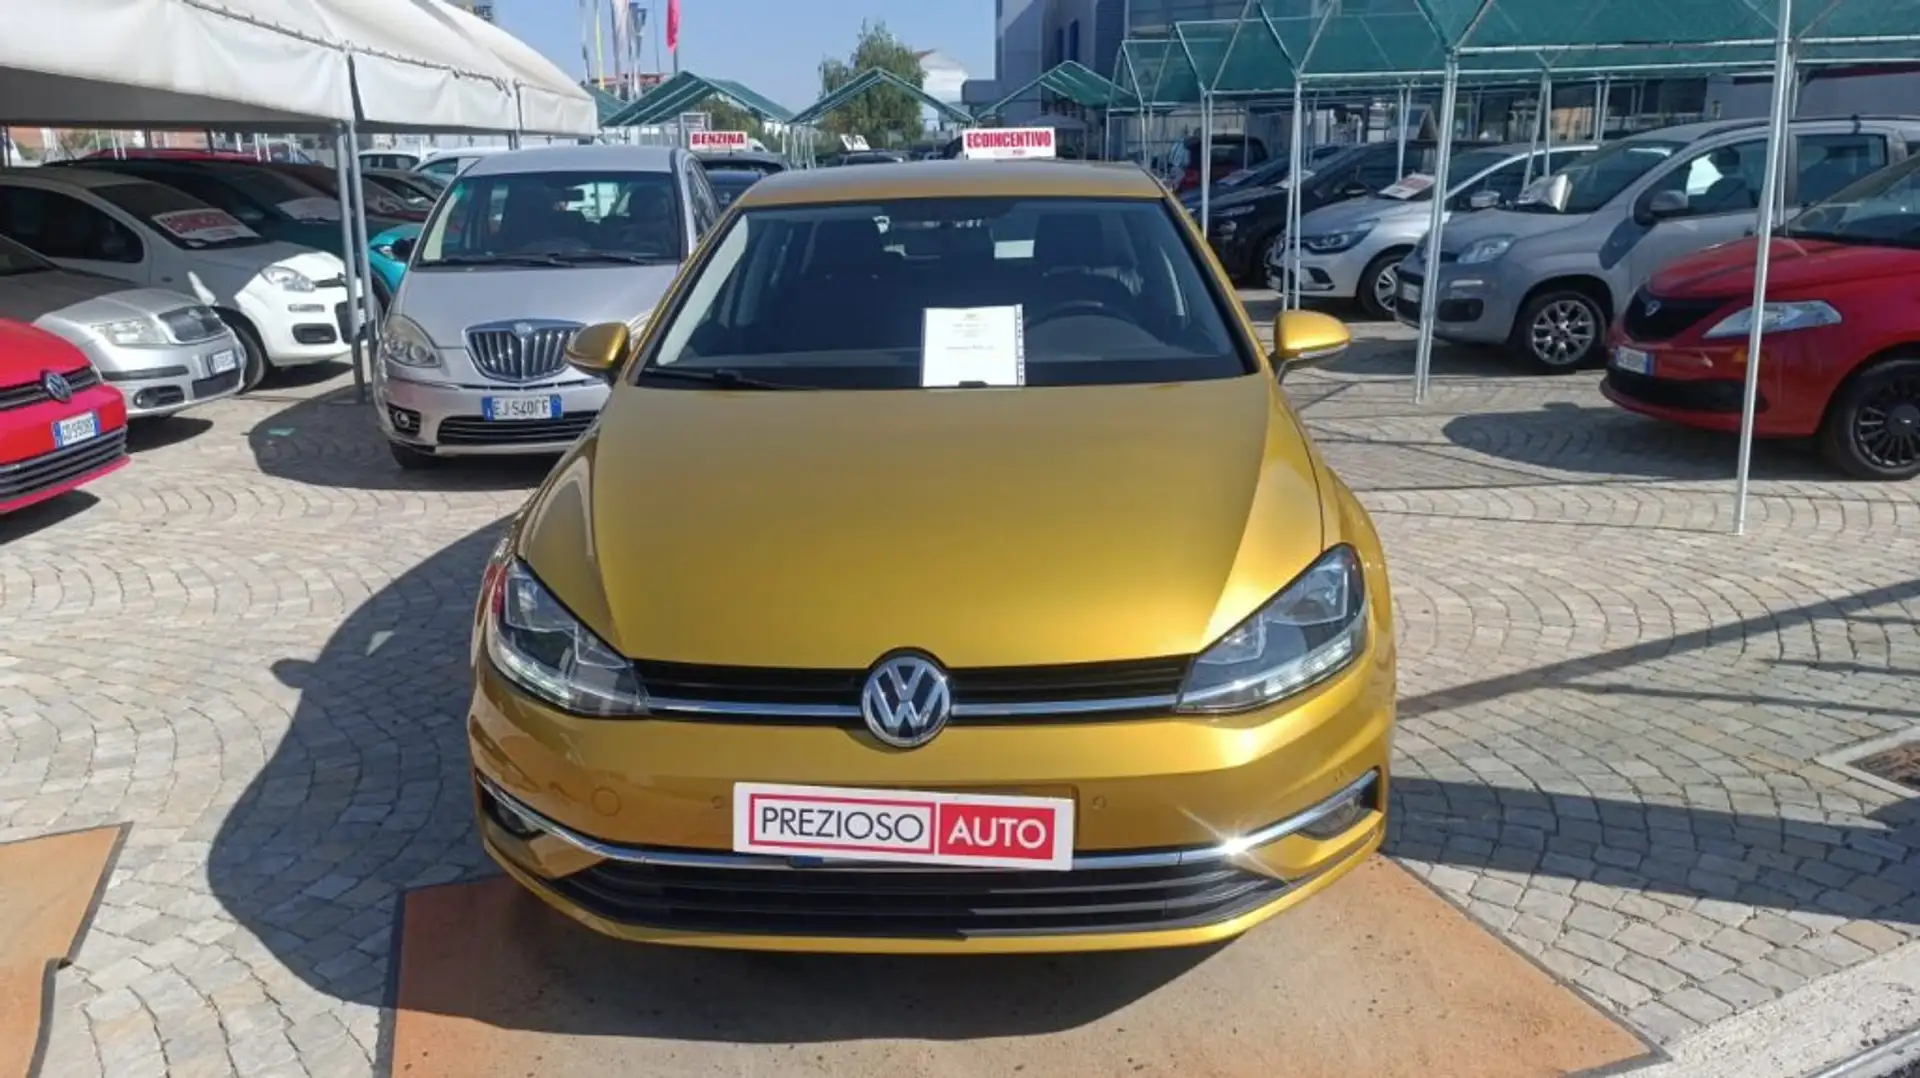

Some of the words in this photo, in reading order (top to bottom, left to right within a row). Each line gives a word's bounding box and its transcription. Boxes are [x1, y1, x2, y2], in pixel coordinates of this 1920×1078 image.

[692, 133, 744, 145] BENZINA
[967, 131, 1051, 148] ECOINCENTIVO
[762, 806, 924, 843] PREZIOSO
[947, 815, 1047, 849] AUTO
